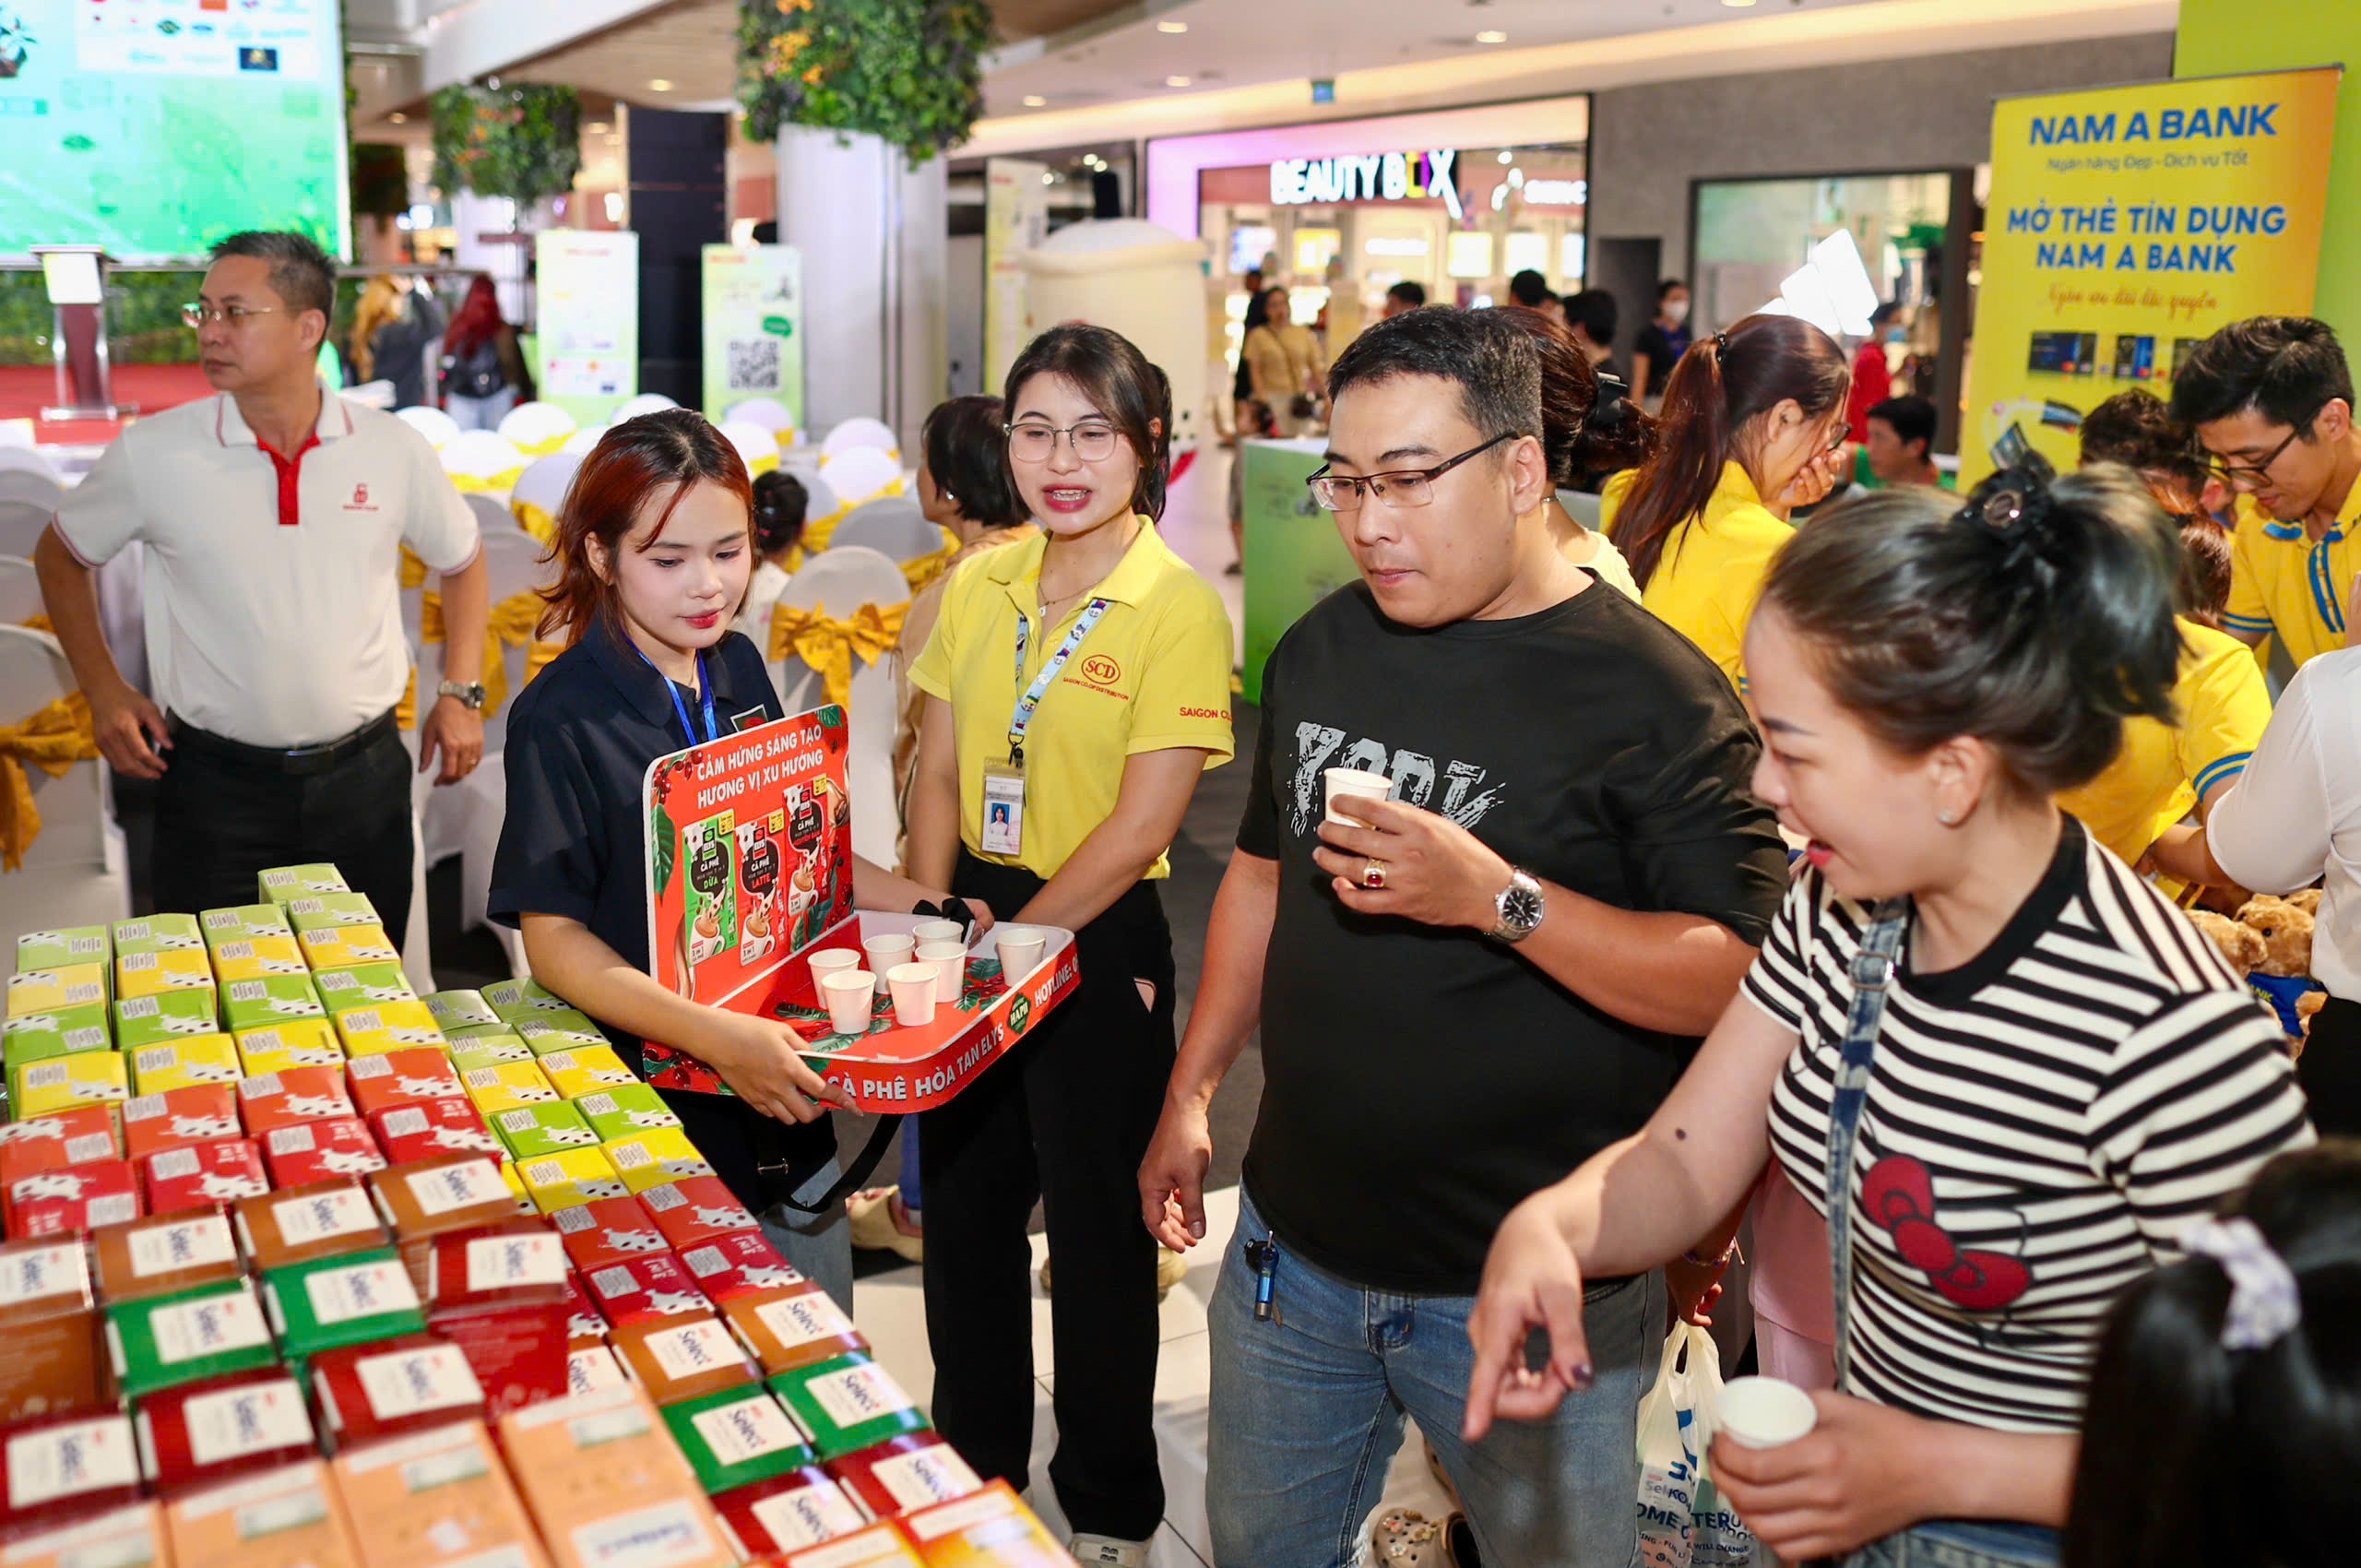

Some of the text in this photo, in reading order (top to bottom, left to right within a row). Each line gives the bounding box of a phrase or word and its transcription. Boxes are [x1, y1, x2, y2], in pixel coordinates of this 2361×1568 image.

[2030, 103, 2280, 146] NAM A BANK
[2007, 196, 2287, 240] MỞ THẺ TÍN DỤNG
[2035, 243, 2237, 272] NAM A BANK
[1086, 659, 1116, 679] SCD
[1180, 707, 1218, 719] SAIGON
[697, 724, 823, 781] CẢM HỨNG SÁNG TẠO
[697, 748, 824, 810] HƯƠNG VỊ XU HƯỚNG
[753, 873, 772, 889] LATTE
[1034, 963, 1073, 1008] HOTLINE:
[863, 1075, 908, 1101] PHÊ
[915, 1065, 955, 1099] HÒA
[955, 1046, 979, 1075] TAN
[980, 1021, 1004, 1055] ELYS
